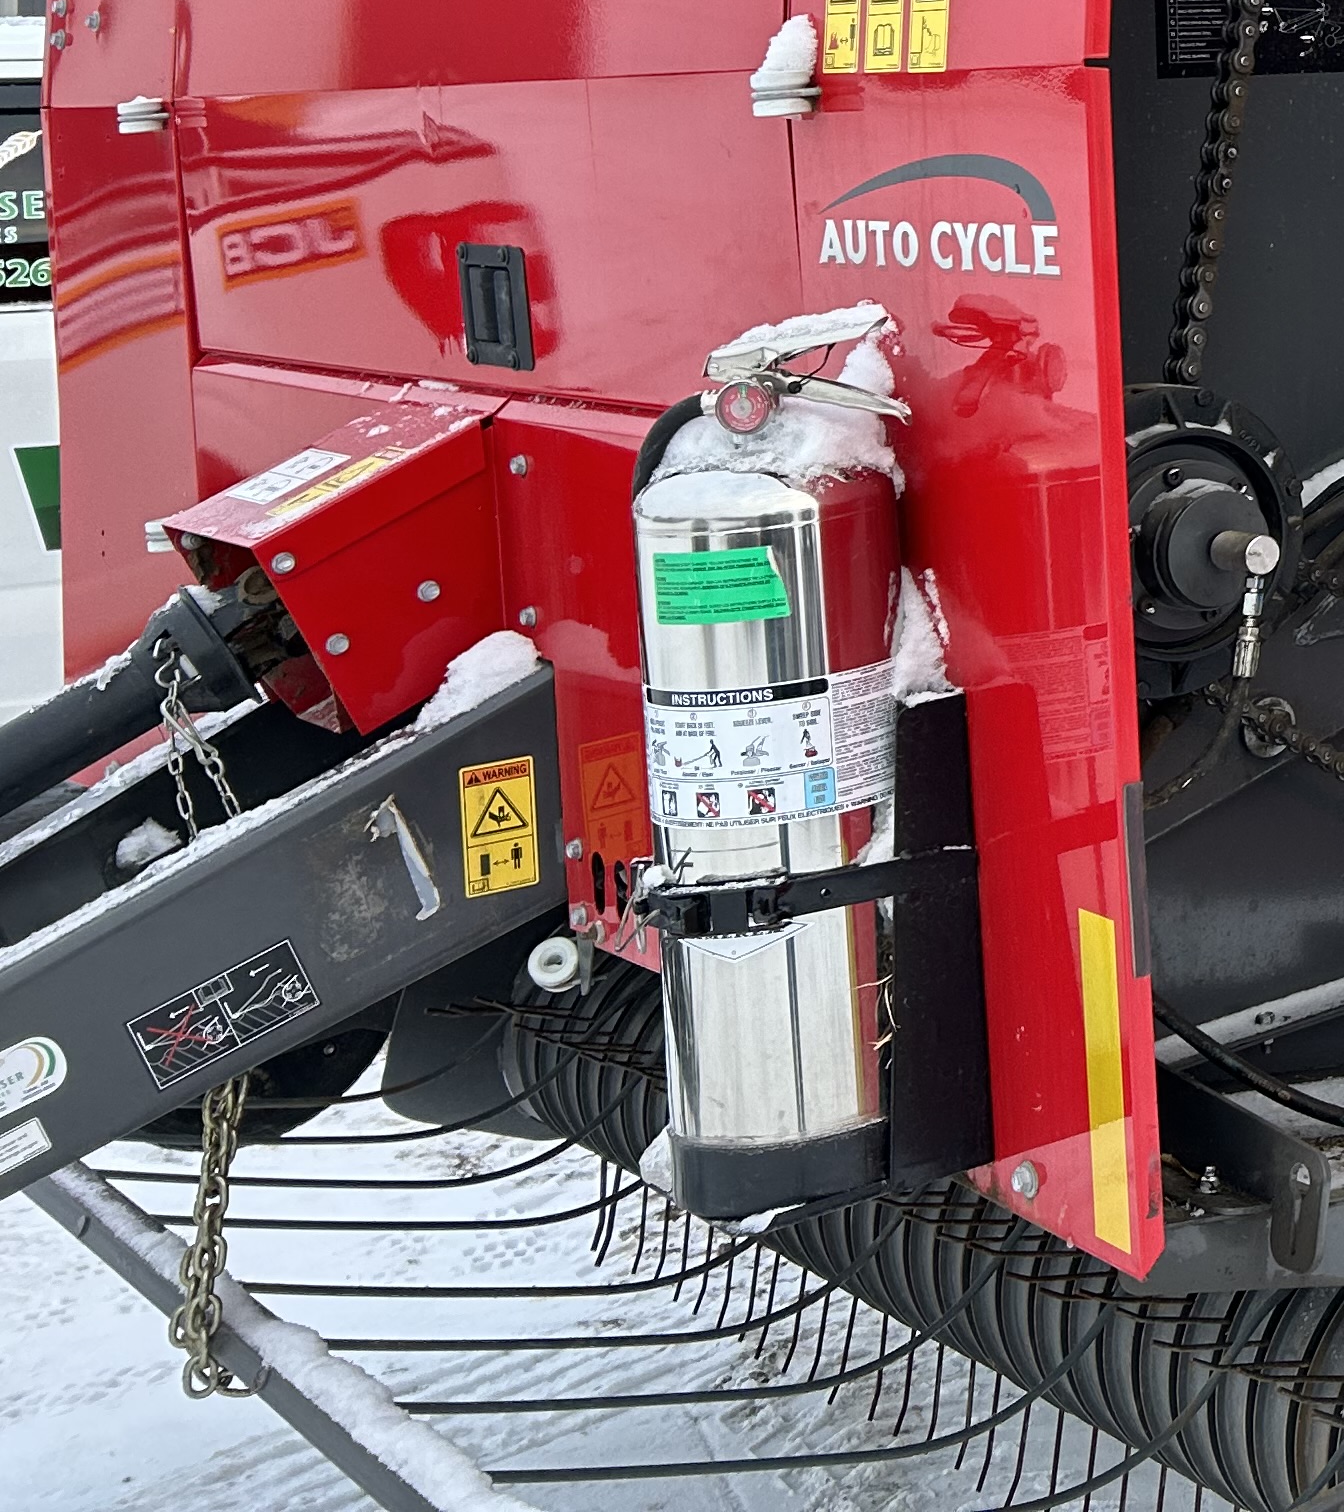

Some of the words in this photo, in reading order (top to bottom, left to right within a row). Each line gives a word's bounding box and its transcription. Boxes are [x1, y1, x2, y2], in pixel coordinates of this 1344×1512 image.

[0, 190, 46, 221] SE
[819, 219, 919, 268] AUTO
[930, 221, 1062, 277] CYCLE
[671, 688, 774, 706] INSTRUCTIONS
[481, 763, 527, 782] WARNING
[0, 1071, 25, 1090] SER
